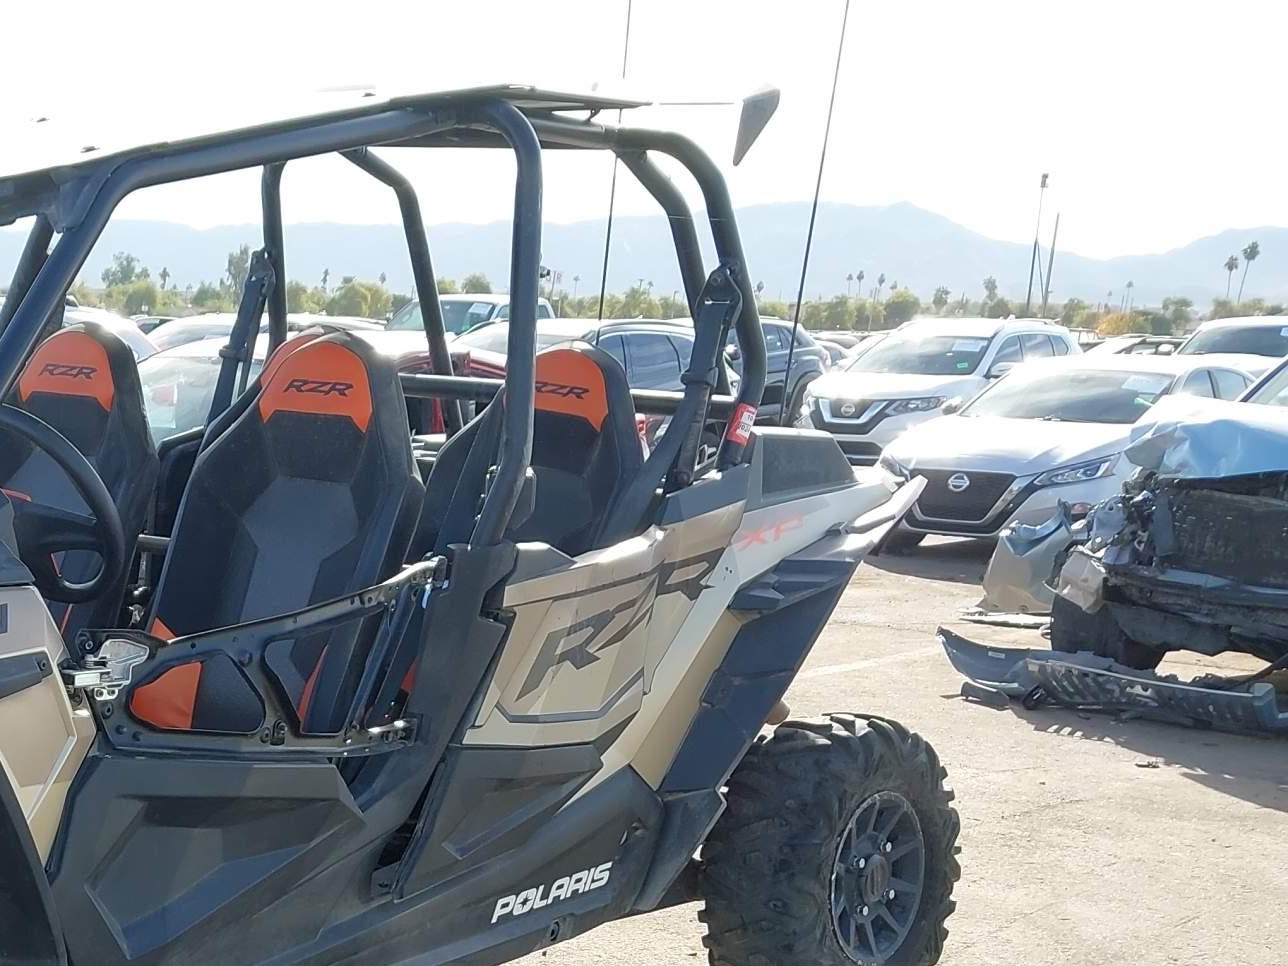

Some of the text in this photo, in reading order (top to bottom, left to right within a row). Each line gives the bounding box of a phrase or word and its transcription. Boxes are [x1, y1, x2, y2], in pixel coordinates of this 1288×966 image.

[38, 363, 98, 380] RZR
[283, 379, 354, 397] RZR
[490, 861, 613, 923] POLARIS
